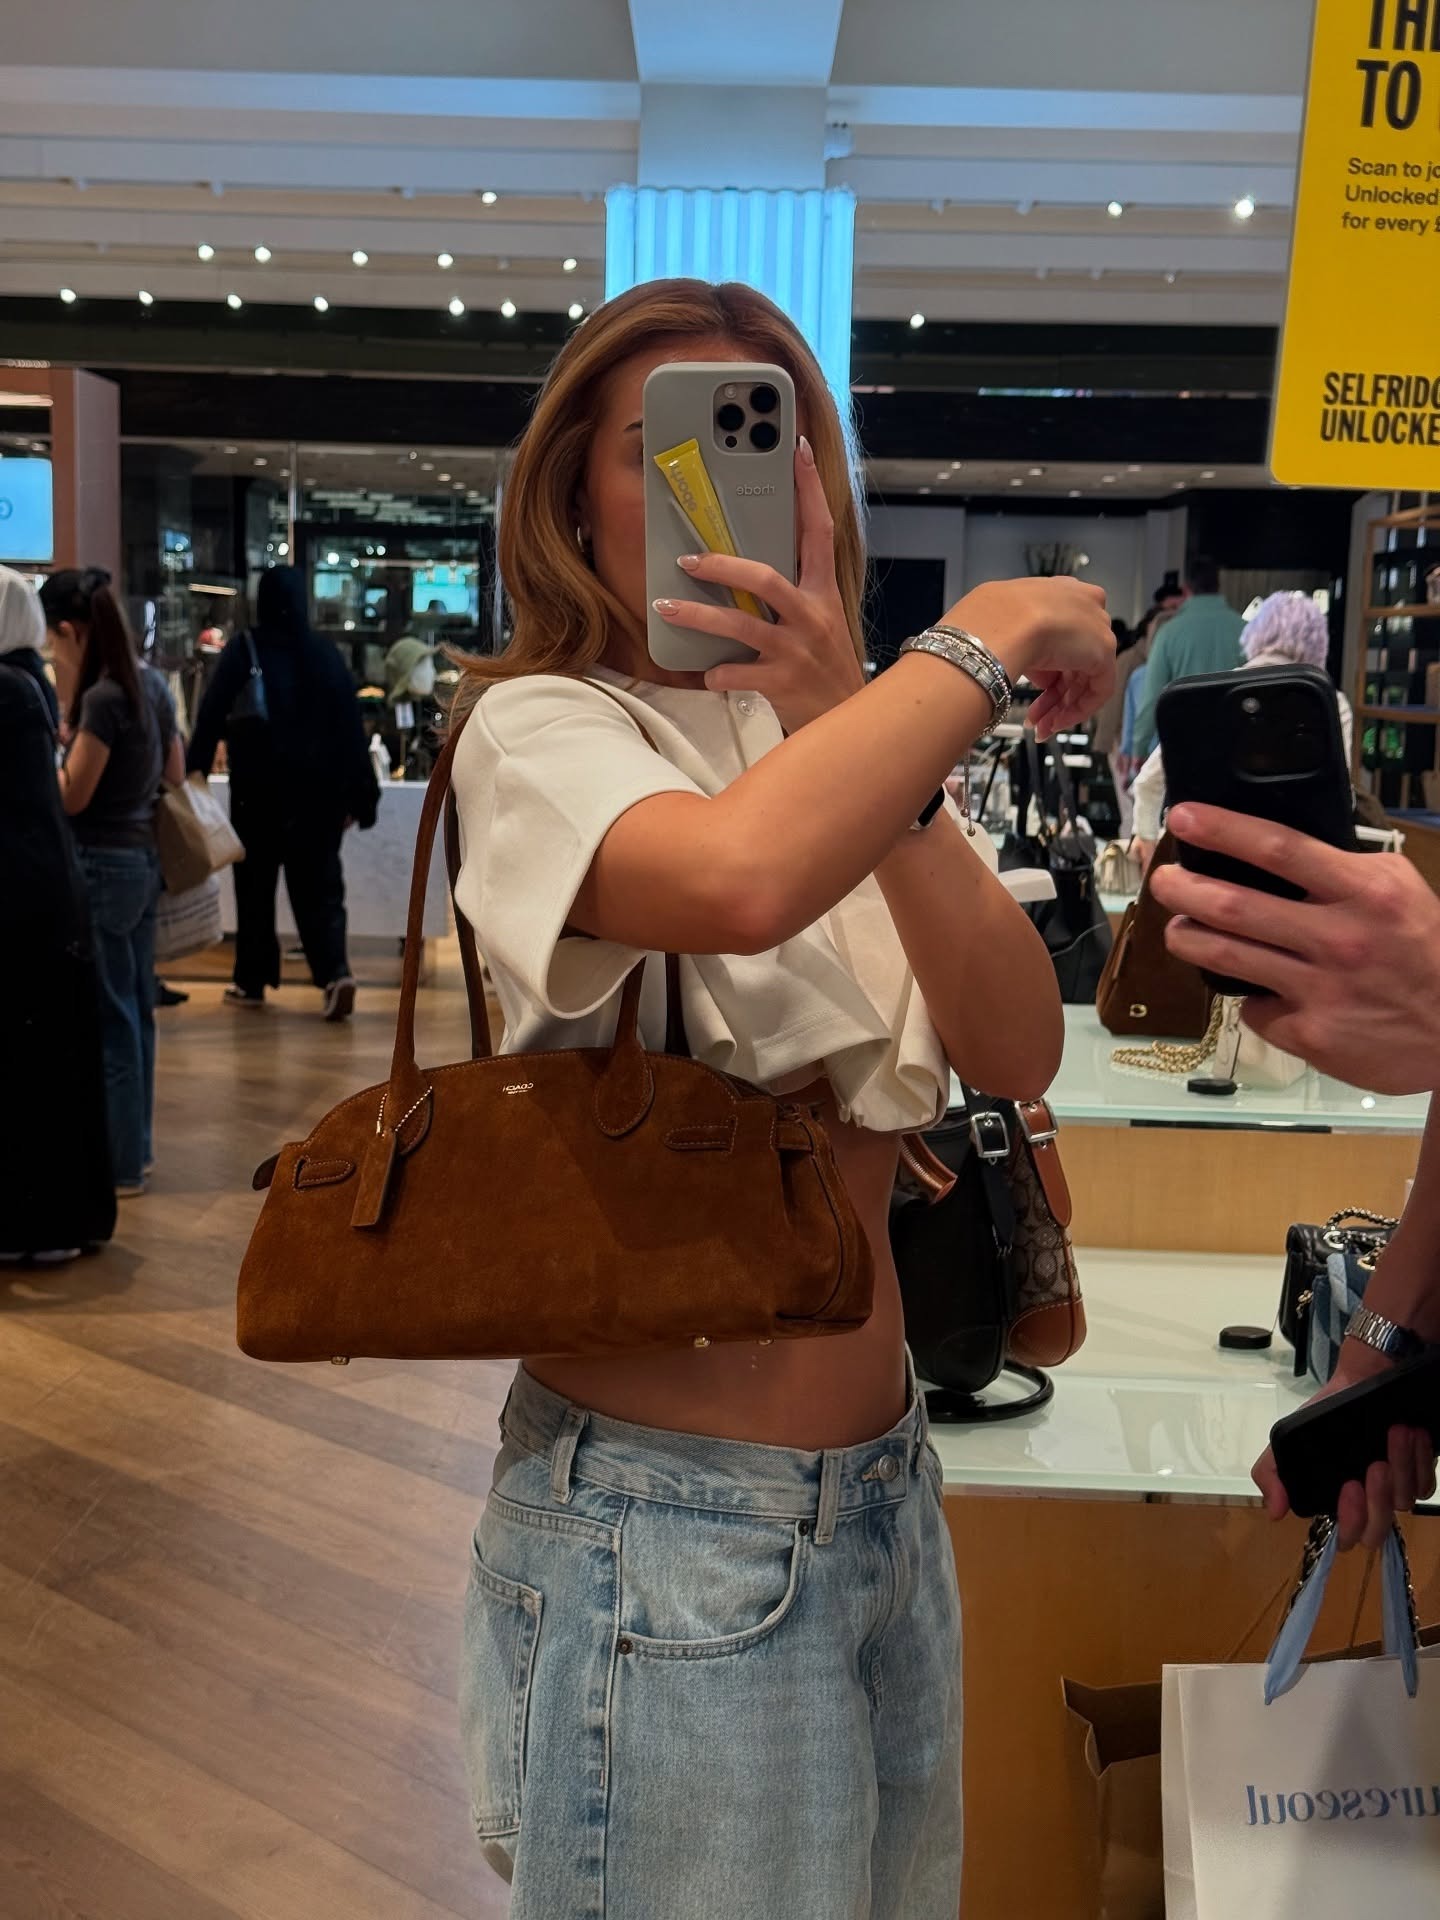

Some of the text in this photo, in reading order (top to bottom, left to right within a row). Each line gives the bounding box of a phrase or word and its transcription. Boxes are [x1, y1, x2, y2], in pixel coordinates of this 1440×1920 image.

[1356, 59, 1421, 130] TO
[1348, 157, 1397, 176] Scan
[1403, 162, 1422, 178] to
[1345, 184, 1439, 206] Unlocked
[1342, 211, 1370, 230] for
[1375, 216, 1430, 236] every
